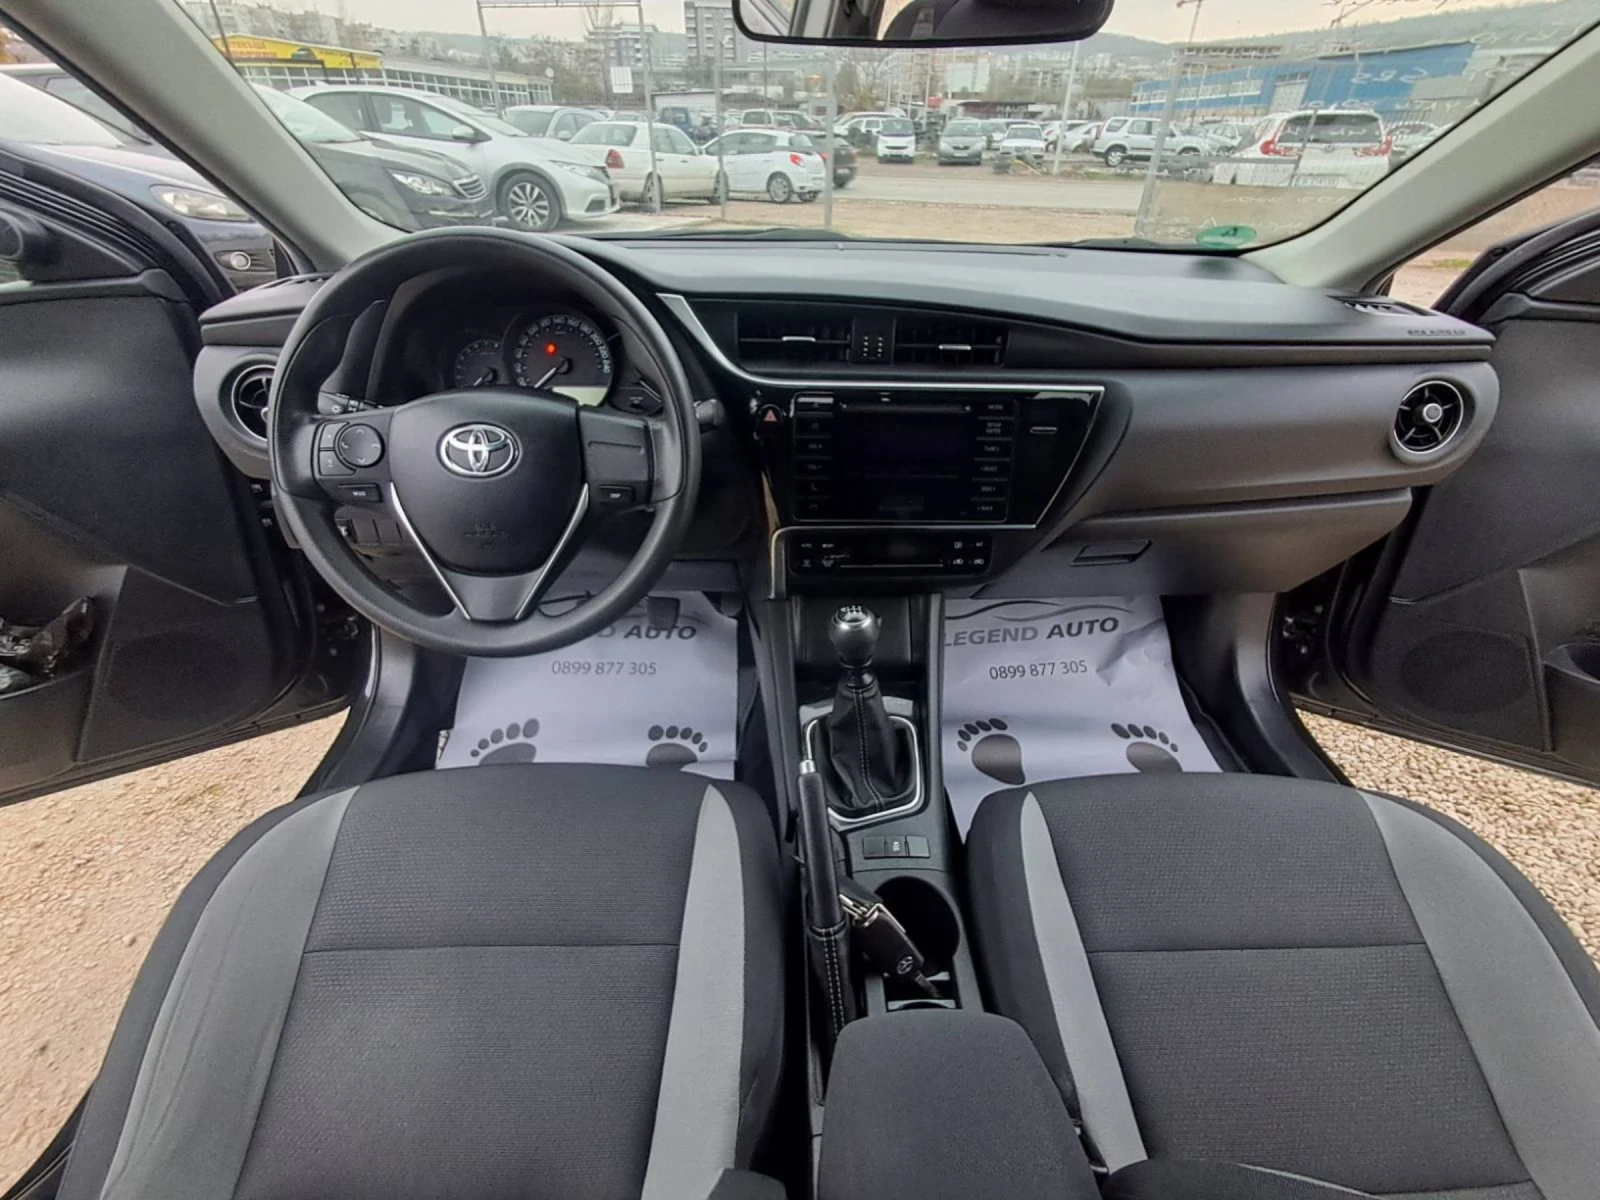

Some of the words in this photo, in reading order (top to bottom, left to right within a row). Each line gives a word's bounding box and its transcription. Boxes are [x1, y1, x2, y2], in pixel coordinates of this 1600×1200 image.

[1046, 617, 1119, 639] AUTO
[551, 660, 592, 675] 0899
[595, 661, 625, 675] 877
[628, 662, 657, 675] 305
[989, 664, 1026, 680] 0899
[1030, 662, 1056, 677] 877
[1062, 660, 1088, 675] 305
